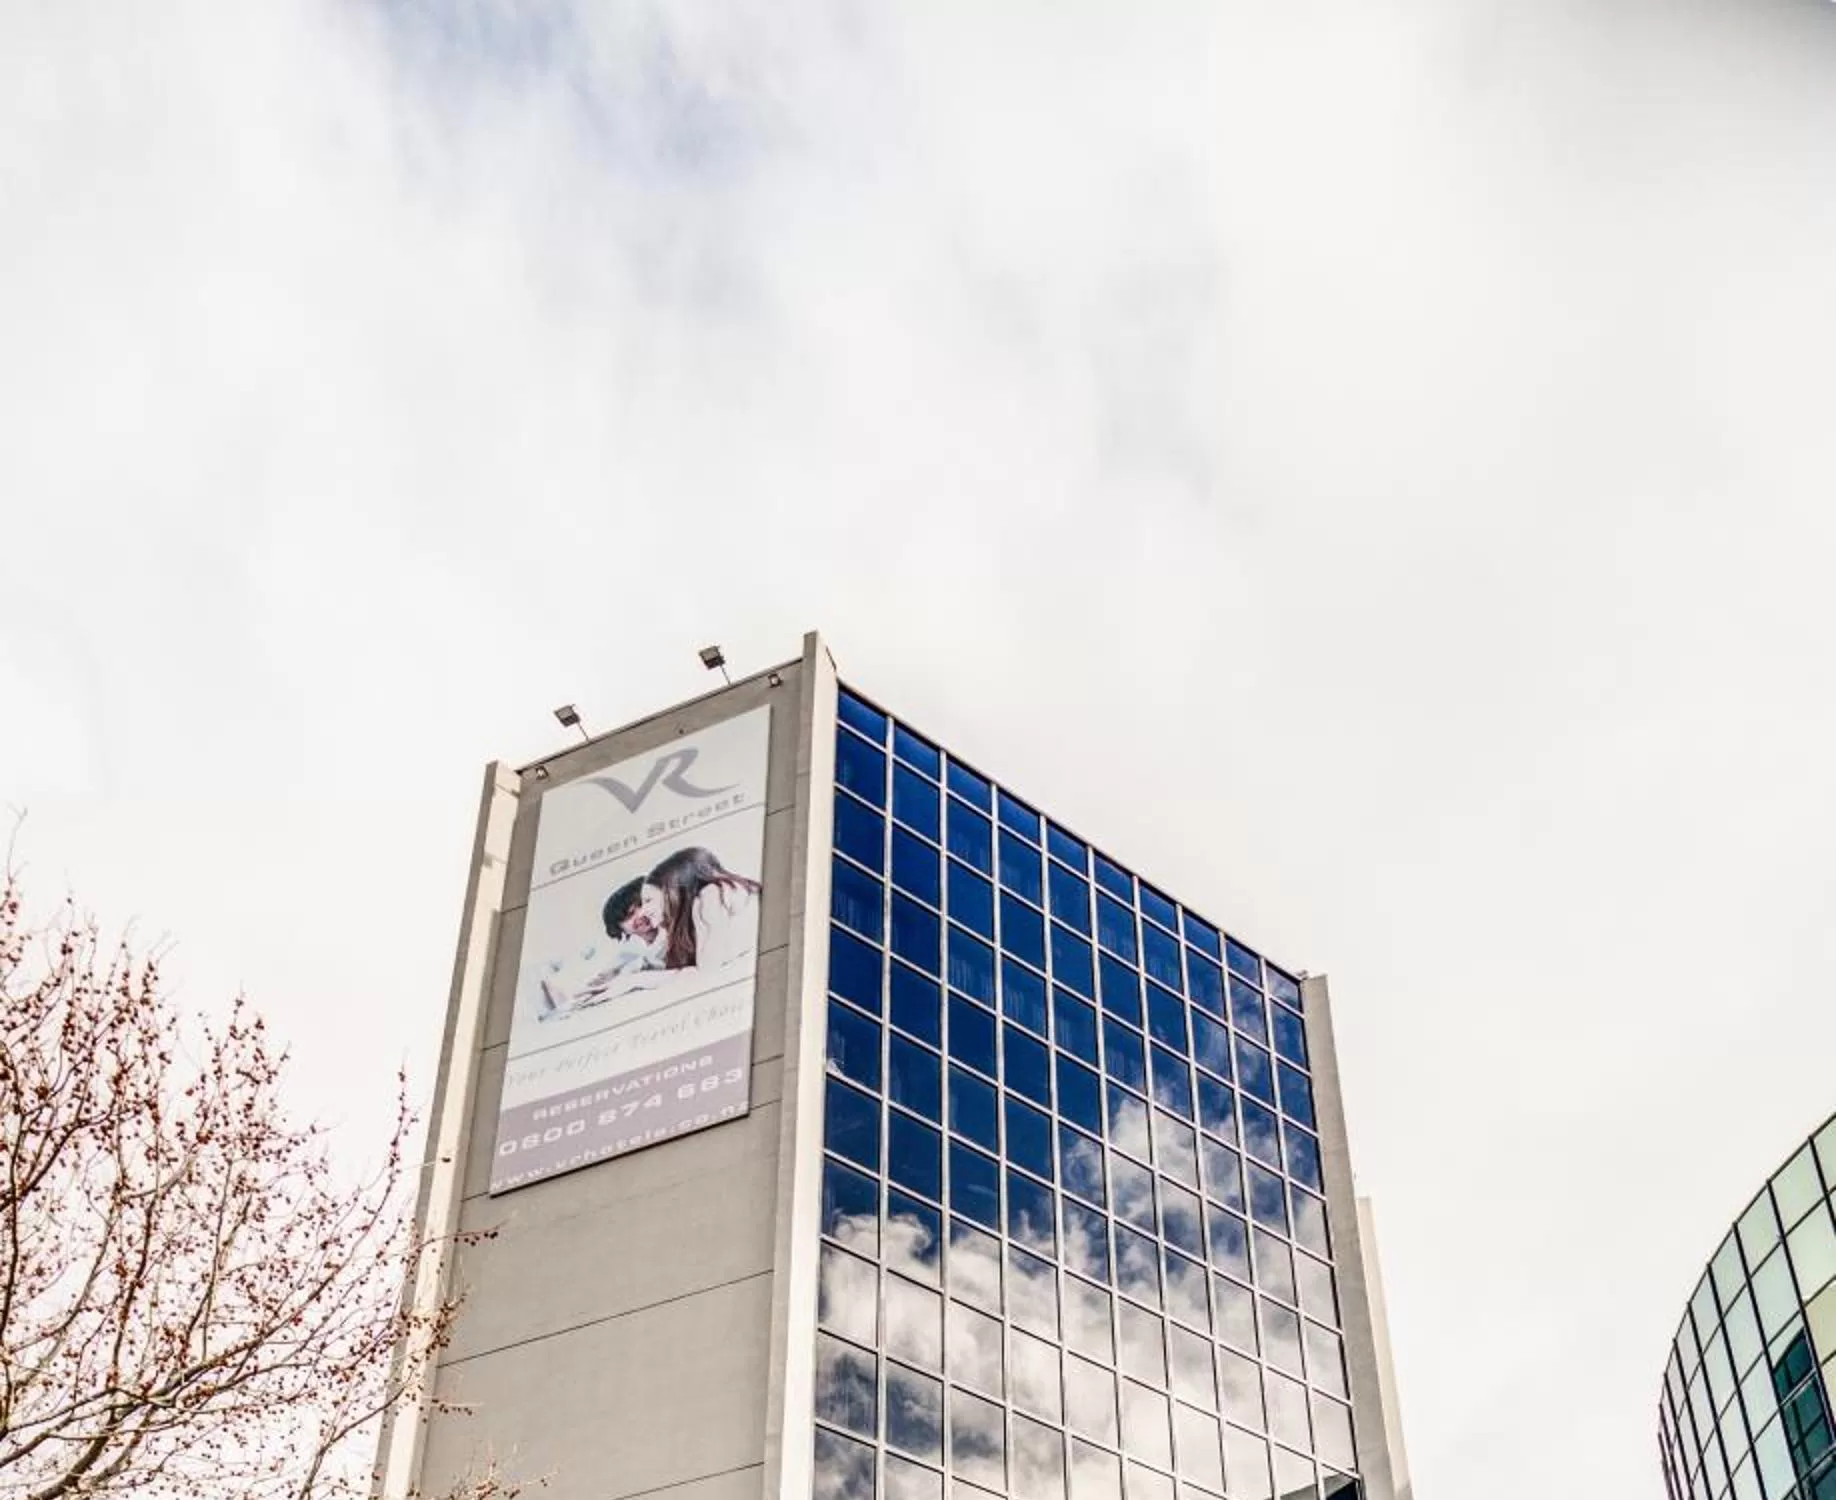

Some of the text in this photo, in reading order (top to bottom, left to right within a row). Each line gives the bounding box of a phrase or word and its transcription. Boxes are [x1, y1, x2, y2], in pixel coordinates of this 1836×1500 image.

[549, 792, 745, 876] Queen Street
[499, 1067, 744, 1156] 0800 874 683
[532, 1055, 714, 1121] RESERVATIONS
